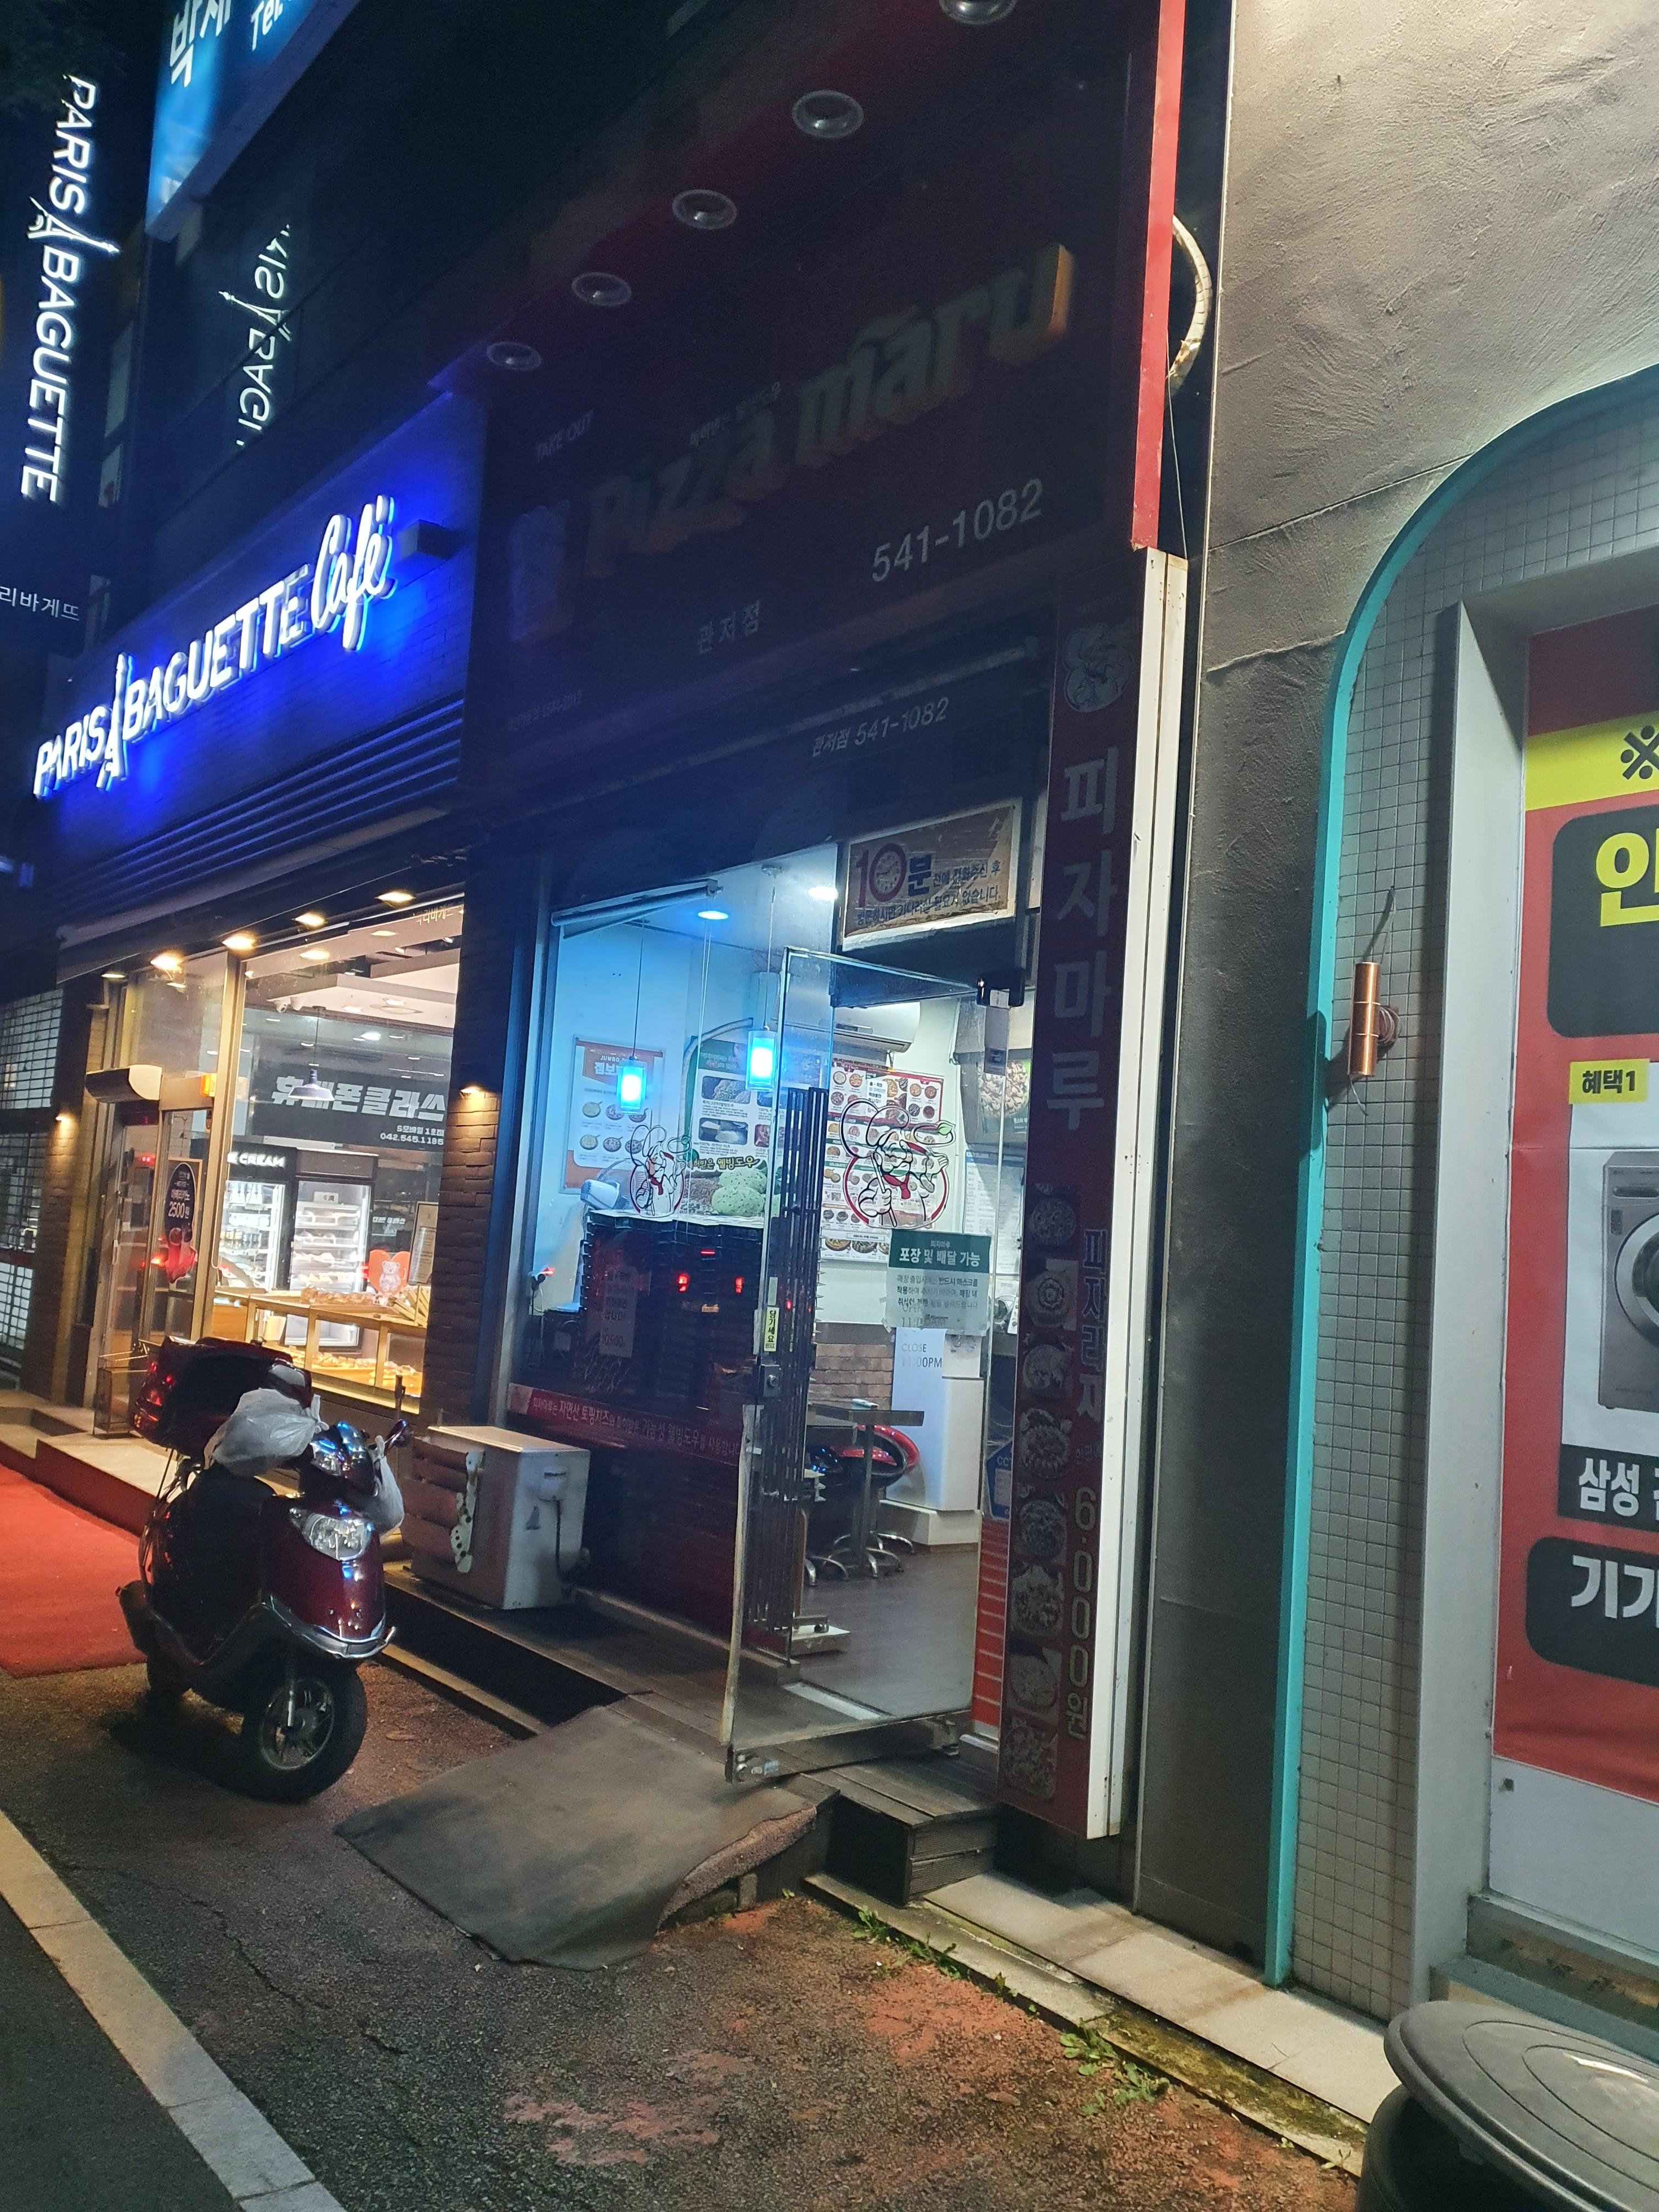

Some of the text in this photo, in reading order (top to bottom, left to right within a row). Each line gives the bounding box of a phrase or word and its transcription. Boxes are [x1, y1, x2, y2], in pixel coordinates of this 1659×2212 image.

[21, 75, 97, 503] PARIS BAGUETTE
[871, 477, 1045, 583] 541-1082
[695, 600, 761, 656] 관저점
[33, 704, 110, 798] PARIS
[123, 563, 312, 743] BAGUETTE
[810, 696, 950, 759] 관저점 541-1082
[991, 860, 1001, 876] 후
[962, 884, 1001, 906] 없습니다.
[1045, 746, 1121, 1131] 피자마루
[1582, 1068, 1636, 1095] 혜택1
[239, 1153, 286, 1168] CREAM
[716, 1155, 755, 1171] 웰빙도우
[168, 1201, 185, 1218] 2500
[930, 1240, 951, 1248] 피자마루
[899, 1247, 981, 1267] 포장 및 배달 가능
[939, 1277, 956, 1286] 반드시
[956, 1278, 978, 1287] 마스크를
[960, 1289, 970, 1298] 매장
[972, 1290, 978, 1298] 내
[901, 1342, 927, 1353] CLOSE
[901, 1356, 943, 1368] 11:00PM
[558, 1400, 579, 1421] 자연산
[1578, 1457, 1640, 1517] 삼성
